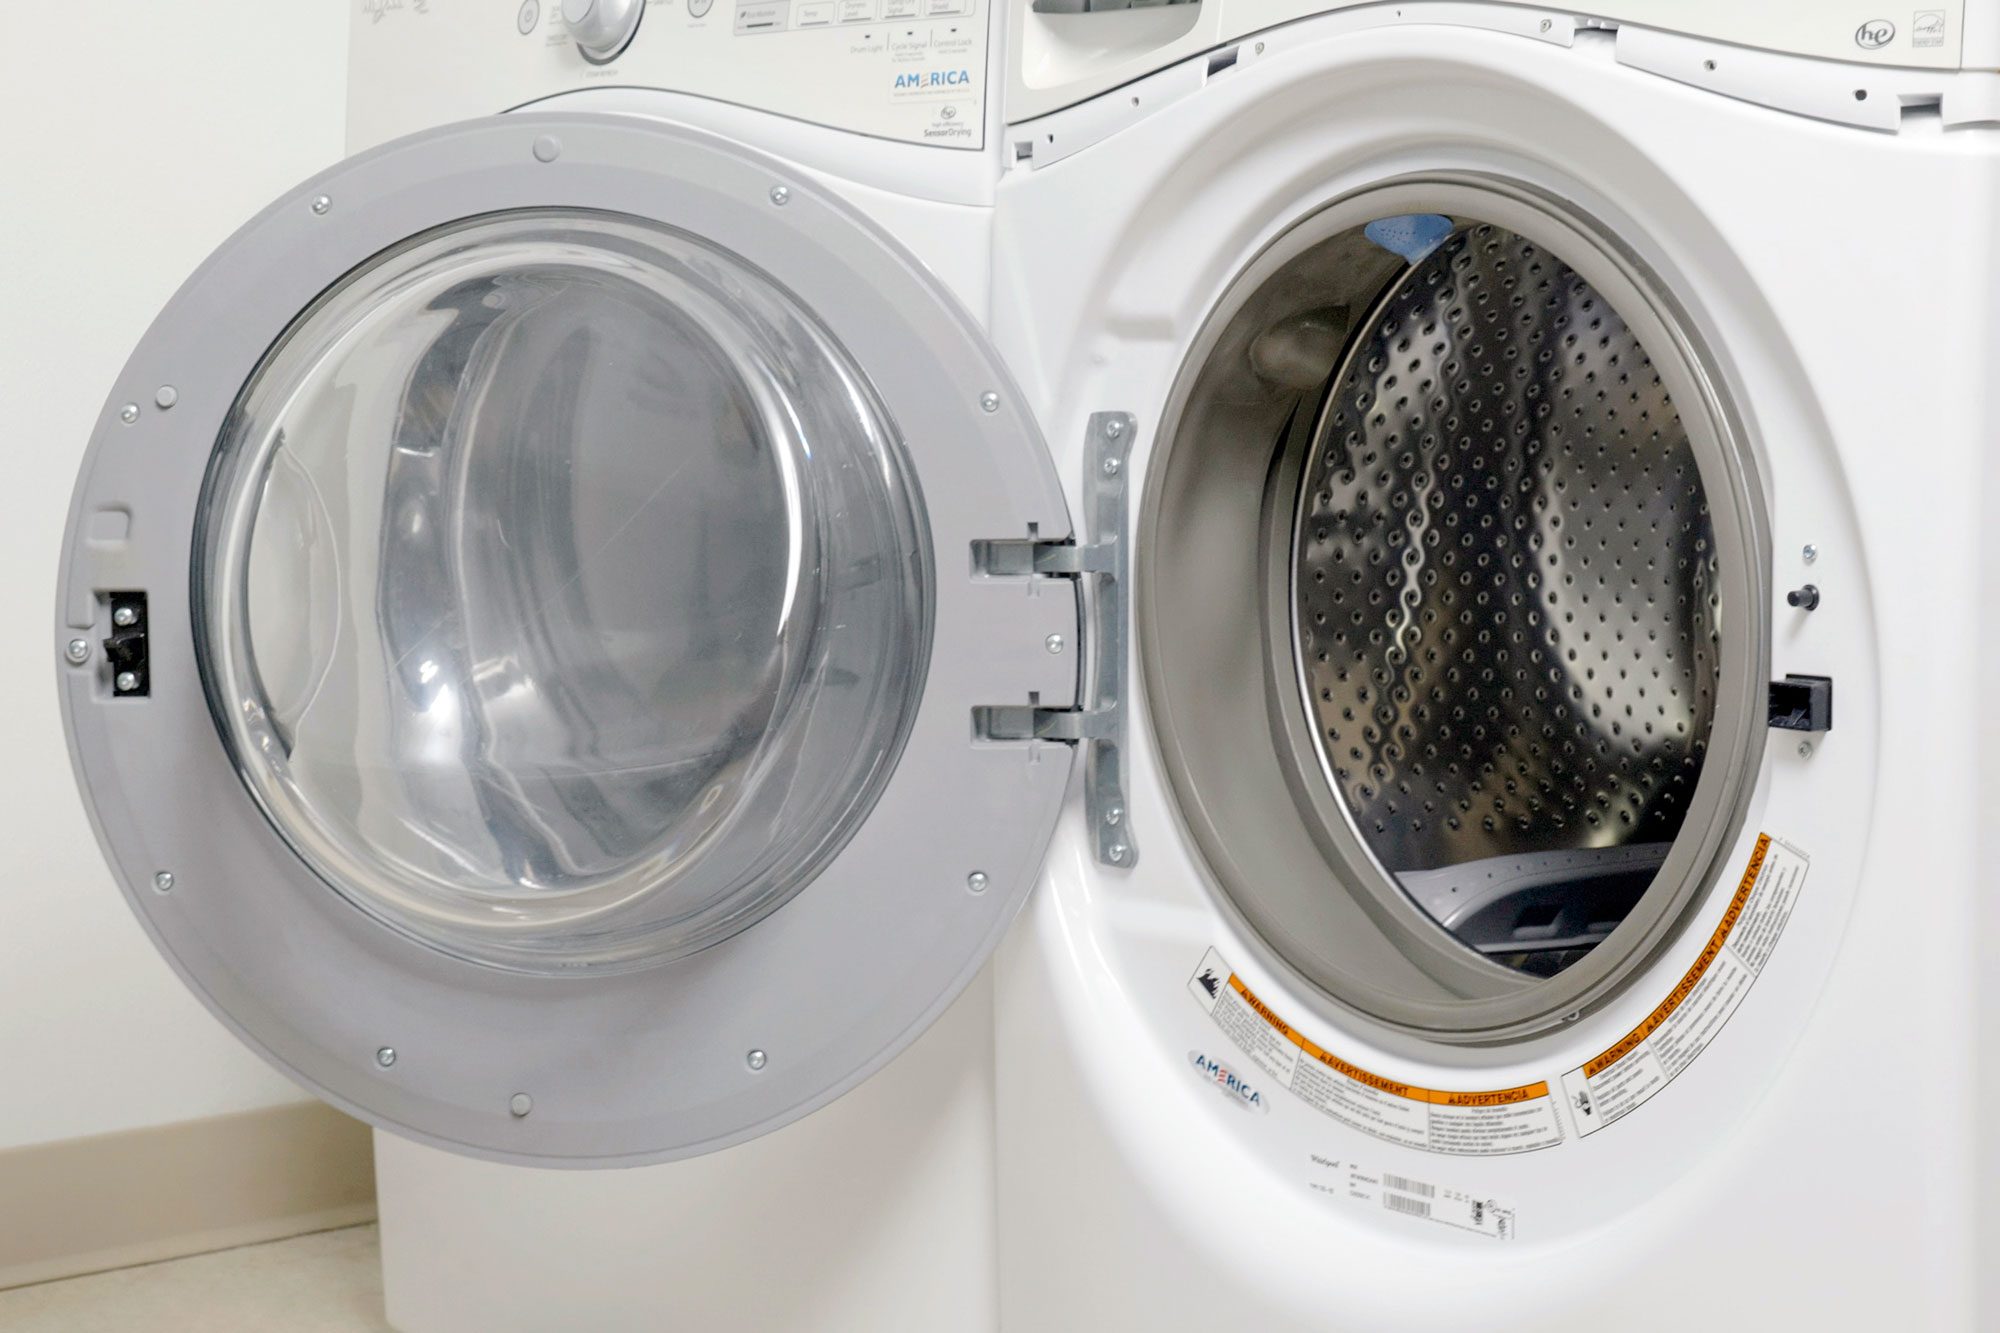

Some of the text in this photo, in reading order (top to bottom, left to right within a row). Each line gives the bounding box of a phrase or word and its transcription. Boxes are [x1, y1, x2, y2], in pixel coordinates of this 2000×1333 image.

[1860, 23, 1888, 46] he
[894, 70, 970, 88] AMERICA
[1725, 837, 1769, 927] ADVERTENCIA
[1652, 939, 1720, 1025] AVERTISSEMENT
[1246, 991, 1289, 1036] WARNING
[1595, 1032, 1641, 1069] WARNING
[1195, 1053, 1261, 1107] AMERICA
[1327, 1056, 1408, 1097] AVERTISSEMENT
[1456, 1089, 1529, 1106] ADVERTENCIA
